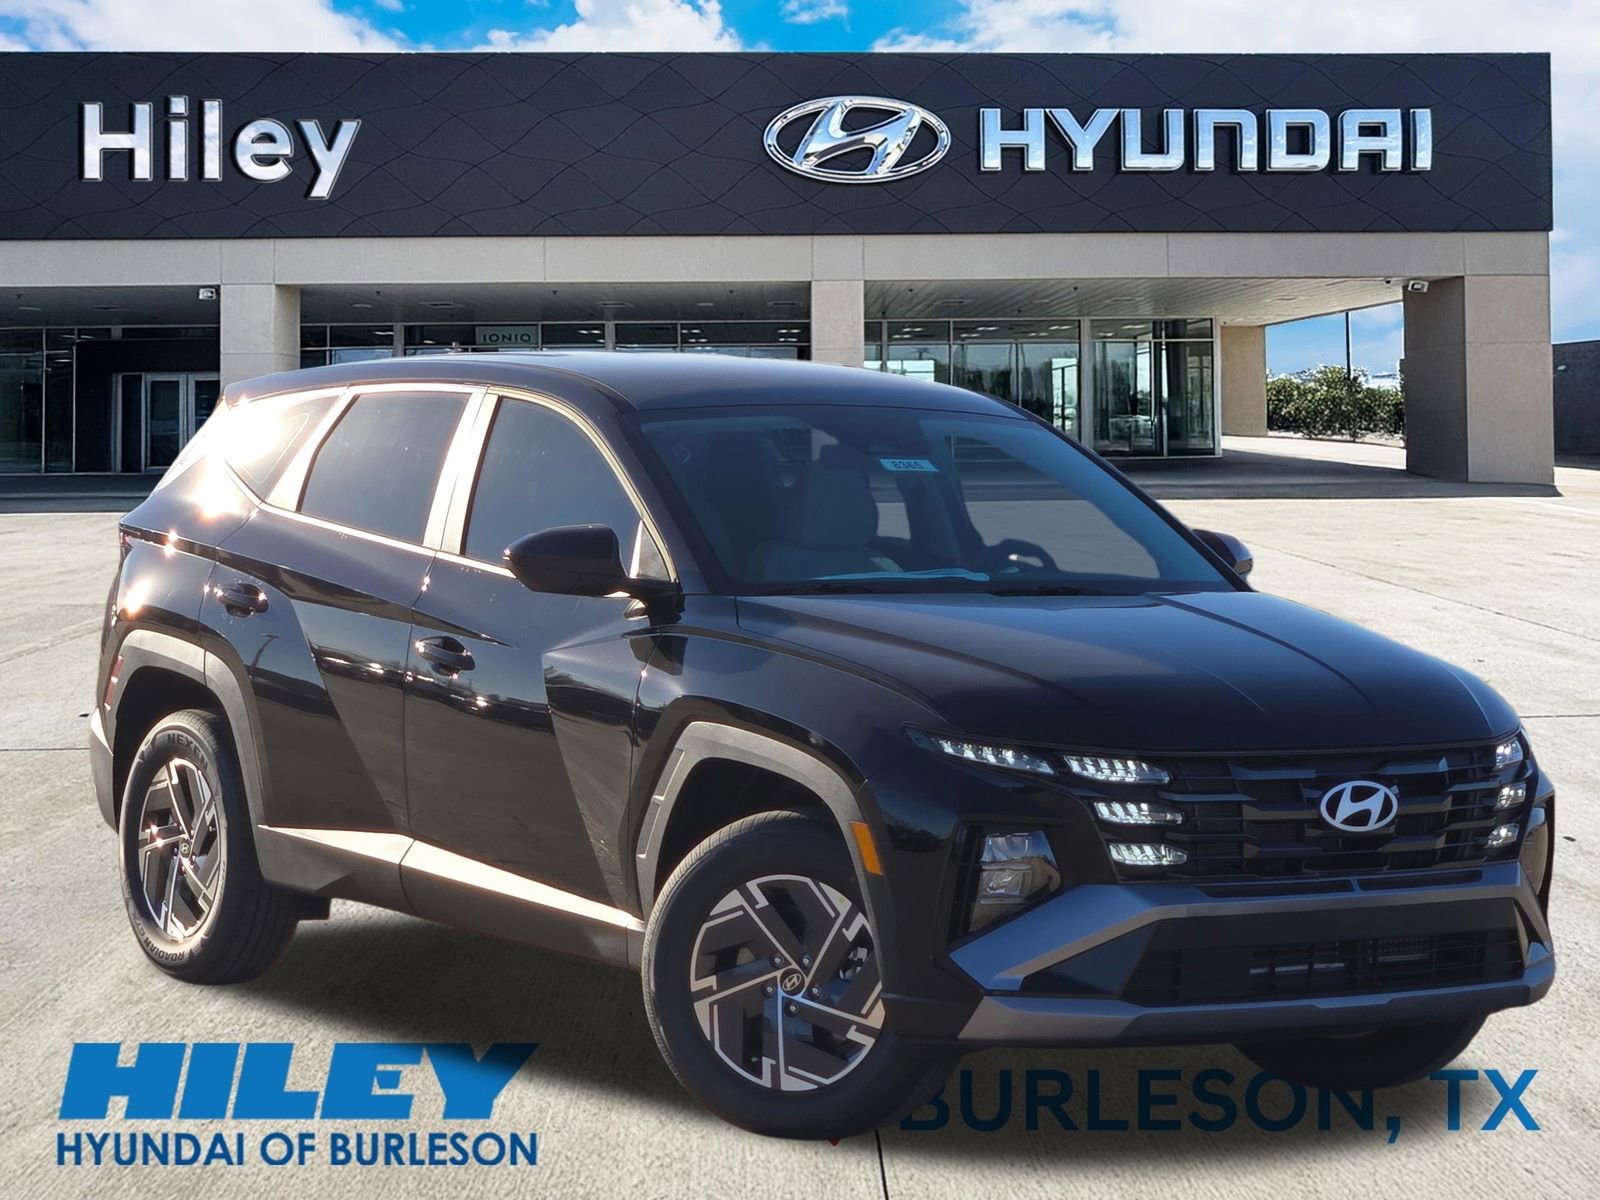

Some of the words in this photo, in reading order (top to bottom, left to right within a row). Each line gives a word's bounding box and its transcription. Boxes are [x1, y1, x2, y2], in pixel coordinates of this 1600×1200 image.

[80, 95, 361, 200] Hiley
[979, 108, 1432, 172] HYUNDAI
[167, 733, 209, 771] NEXEN
[143, 936, 186, 962] ROADIAN
